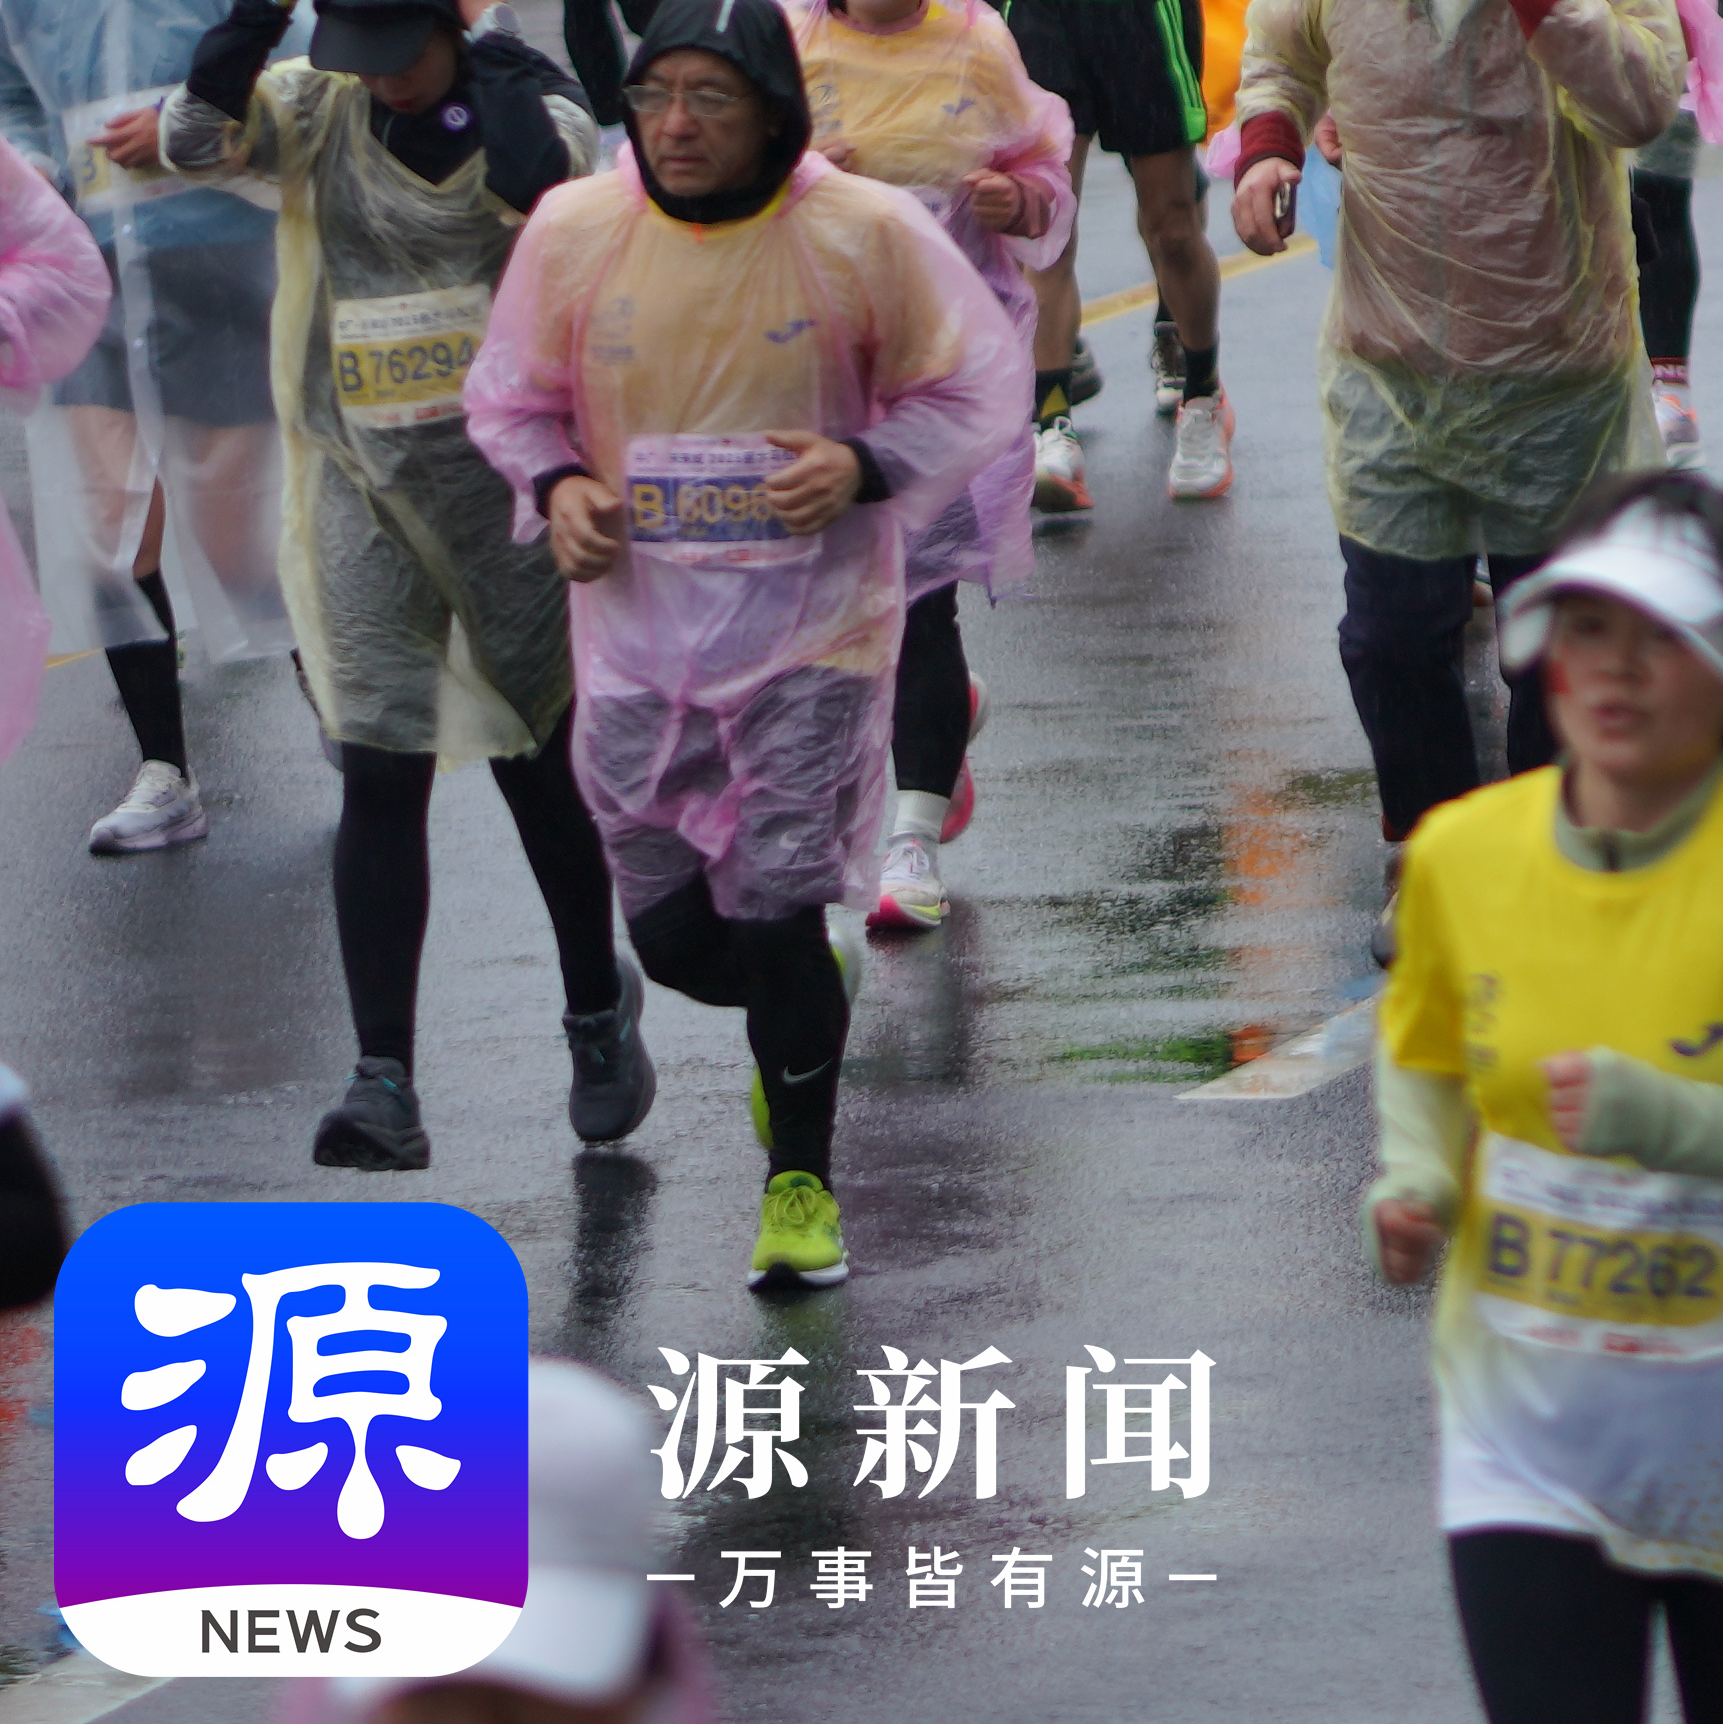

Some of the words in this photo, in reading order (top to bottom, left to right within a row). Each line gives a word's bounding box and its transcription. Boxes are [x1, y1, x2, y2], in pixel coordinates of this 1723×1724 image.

[339, 351, 363, 392] B
[632, 483, 664, 527] B
[1488, 1210, 1529, 1277] B
[1546, 1228, 1718, 1299] 77262
